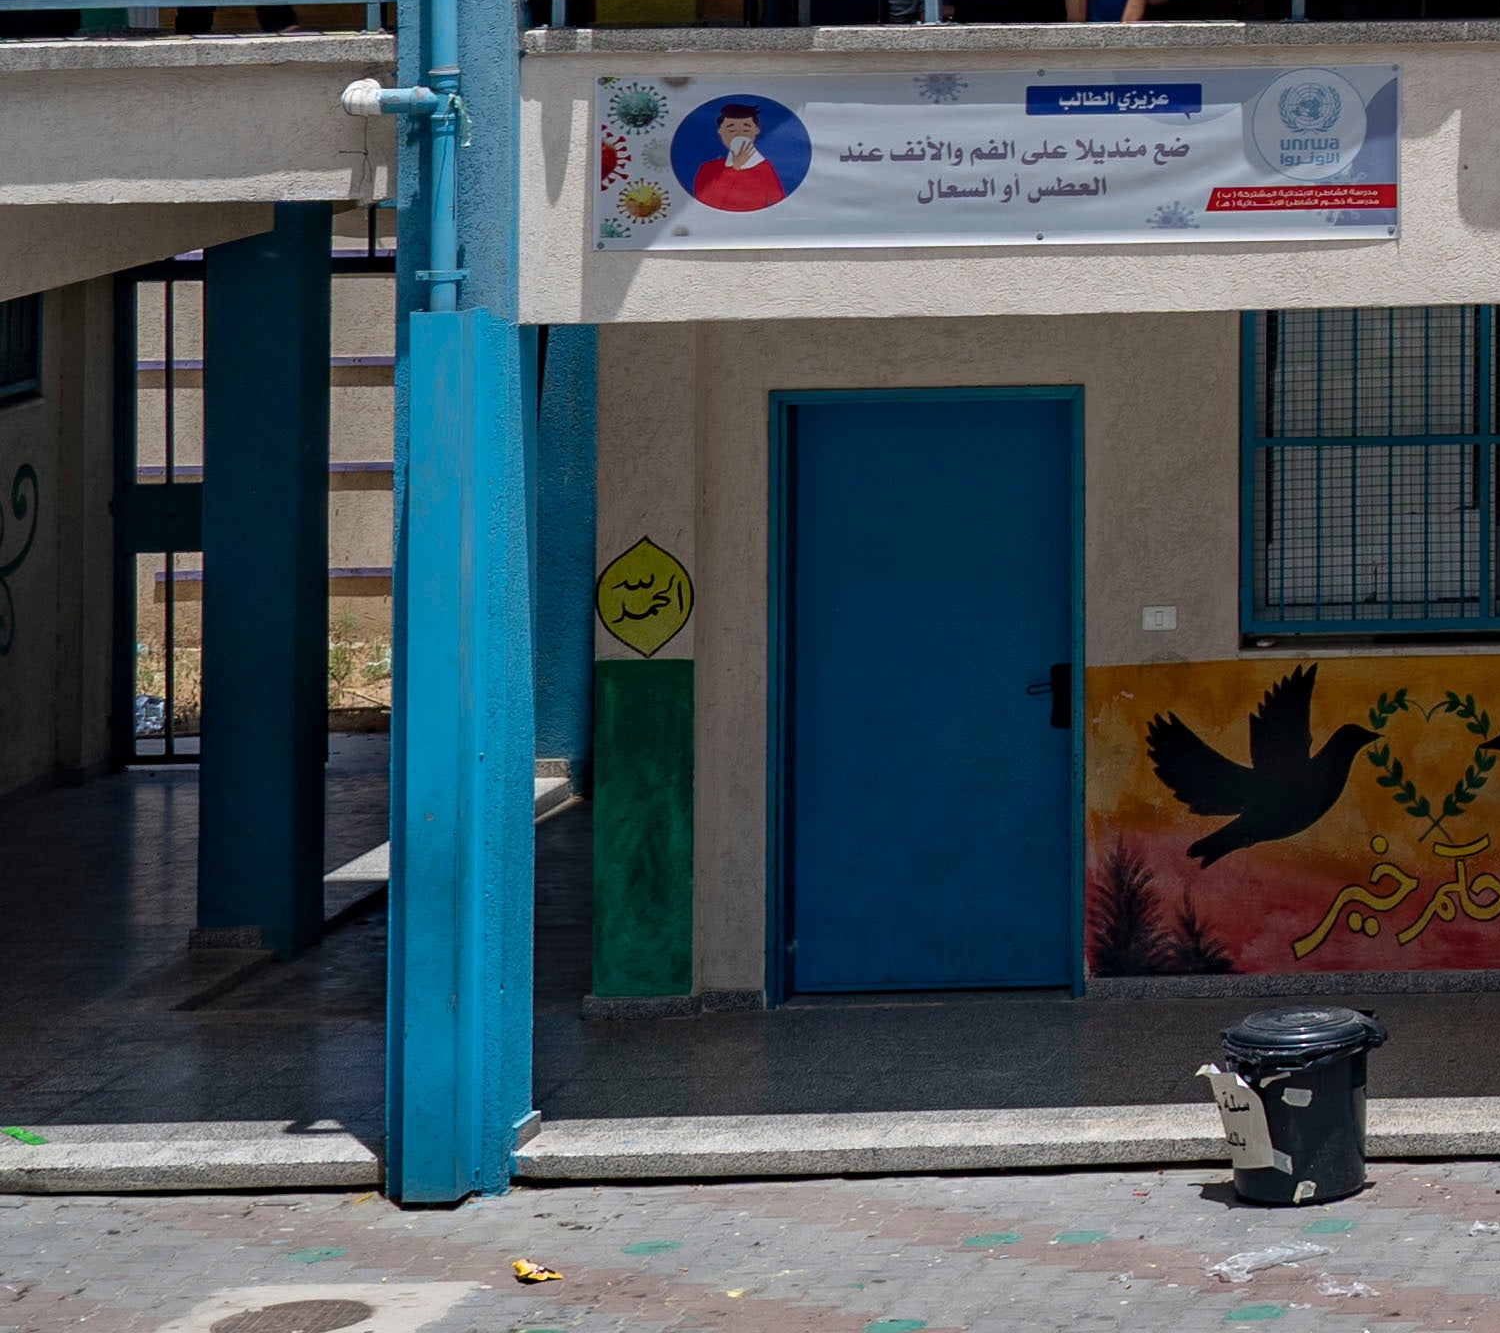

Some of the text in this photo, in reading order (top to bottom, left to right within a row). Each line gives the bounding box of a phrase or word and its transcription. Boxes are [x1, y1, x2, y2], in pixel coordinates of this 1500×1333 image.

[1058, 90, 1170, 110] عزيزي الطالب
[840, 135, 1191, 166] ضع منديلا على الفم والأنف عند
[1279, 137, 1340, 150] unrwa
[916, 172, 1107, 204] العطس أو السعال
[1349, 188, 1378, 197] مدرسة
[1346, 198, 1380, 206] مدرسة
[612, 572, 684, 624] الحمد لله
[1292, 834, 1419, 961] خير
